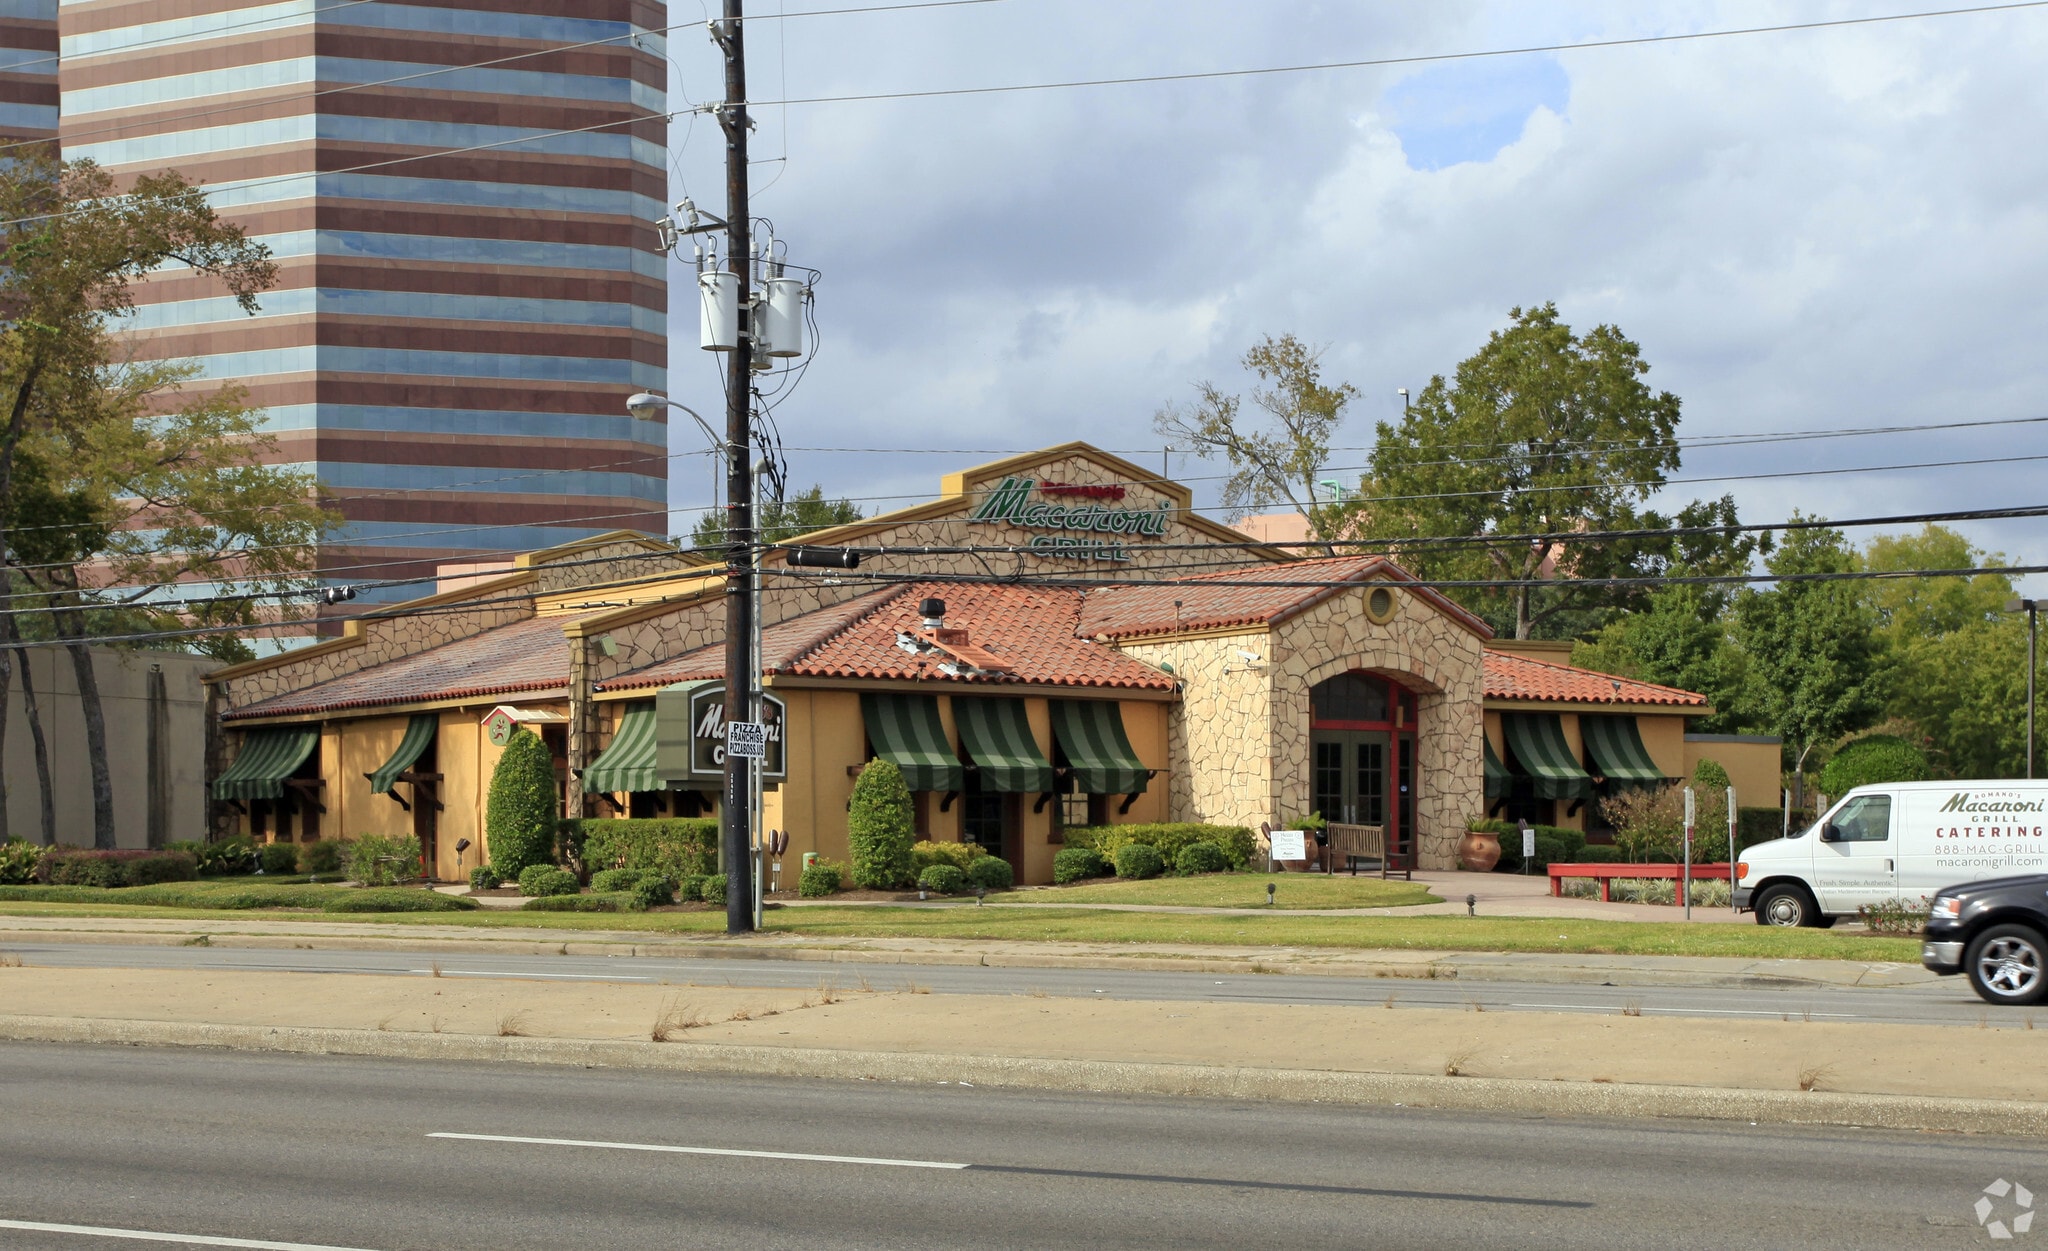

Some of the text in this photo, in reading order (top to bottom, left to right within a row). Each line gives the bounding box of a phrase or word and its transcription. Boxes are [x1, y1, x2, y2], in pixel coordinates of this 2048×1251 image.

[968, 477, 1171, 536] Macaroni
[1031, 535, 1131, 562] GRILL
[733, 723, 761, 734] PIZZA
[730, 731, 763, 743] FRANCHISE
[1975, 791, 2021, 799] ROMANO'S
[1939, 792, 2045, 812] Macaroni
[1971, 815, 2019, 823] GRILL
[1936, 826, 2042, 838] CATERING
[1934, 843, 2045, 854] 888-MAC-GRILL
[1936, 854, 2043, 869] macaronigrill.com
